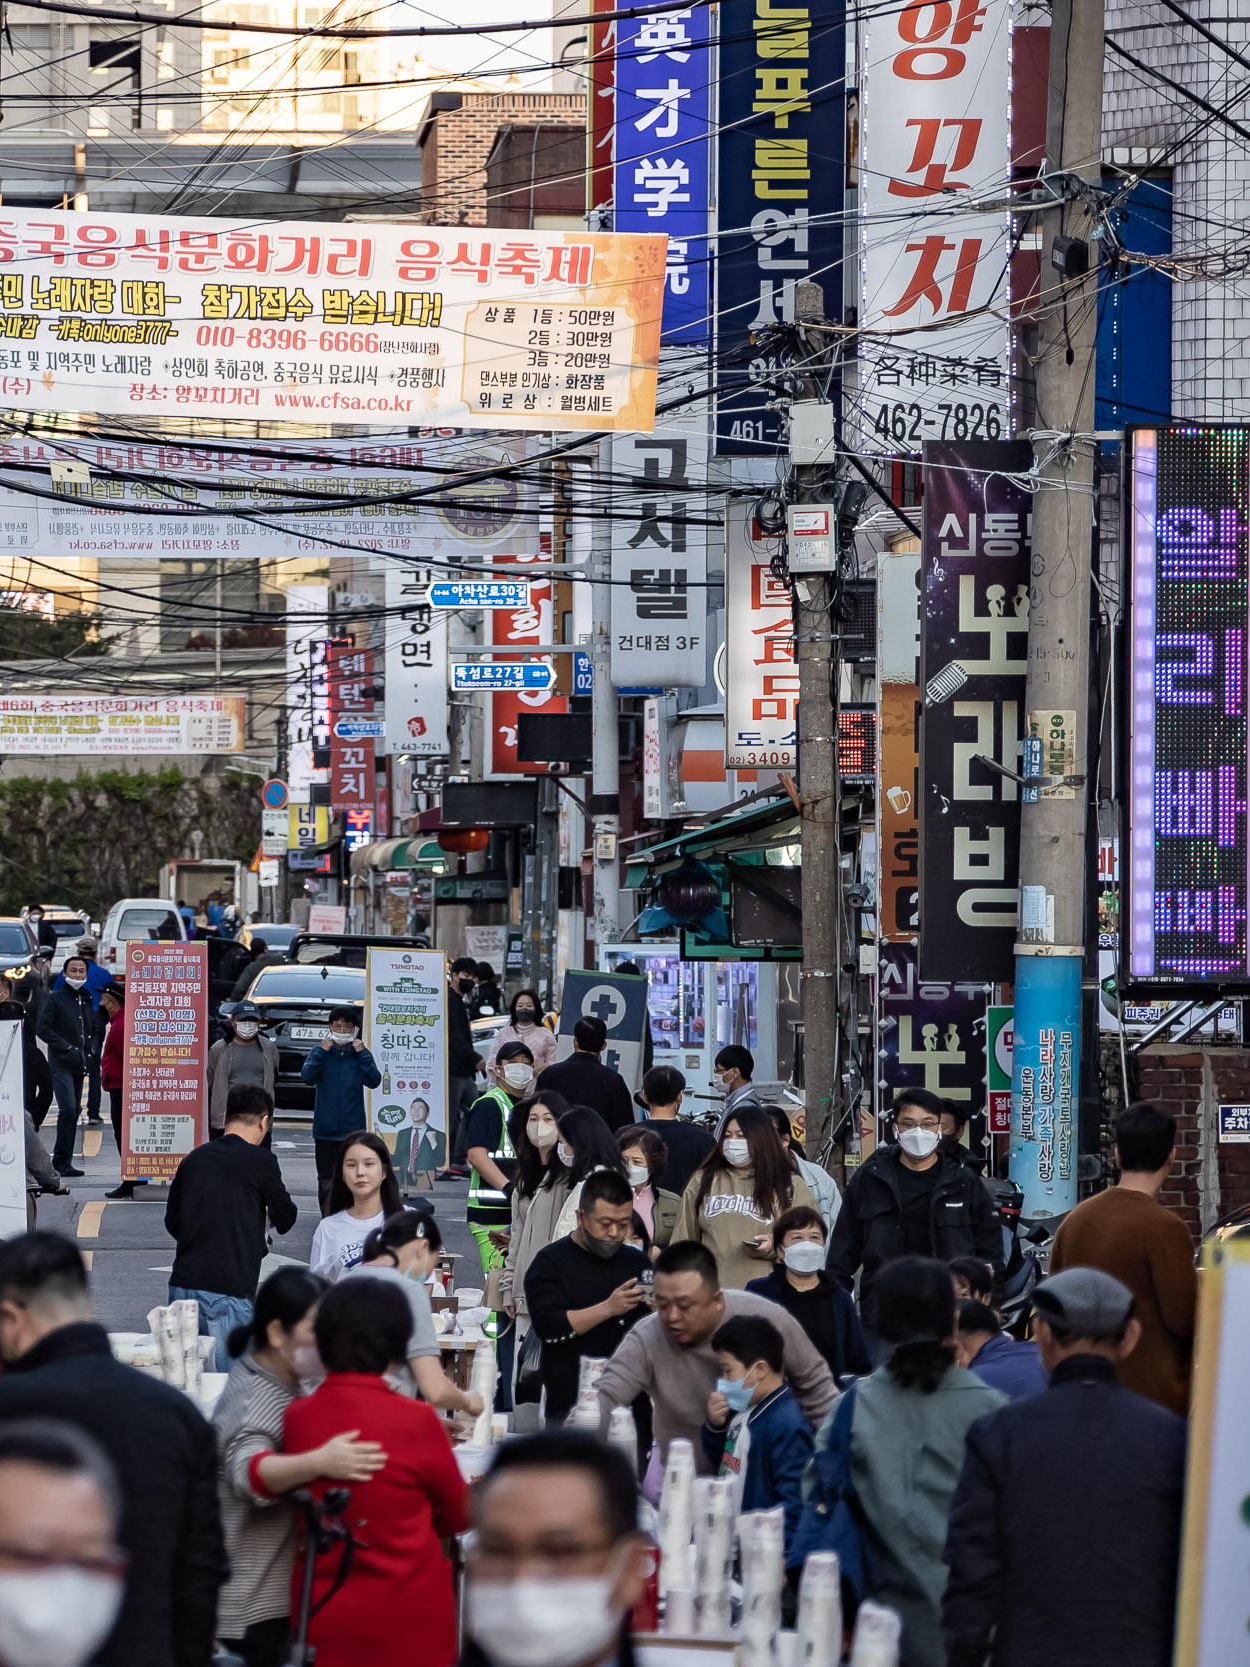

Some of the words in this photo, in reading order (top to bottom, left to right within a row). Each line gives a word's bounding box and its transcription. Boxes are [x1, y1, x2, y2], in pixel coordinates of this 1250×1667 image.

[881, 0, 987, 317] 양꼬치
[395, 239, 591, 285] 음식축제
[31, 275, 116, 315] 노래자랑
[202, 284, 313, 322] 참가접수
[322, 289, 443, 328] 받습니다!
[532, 309, 553, 325] 1등
[568, 310, 615, 326] 50만원
[196, 325, 379, 354] 010-8396-6666
[528, 330, 550, 346] 2등
[566, 332, 612, 348] 30만원
[28, 351, 39, 371] 및
[46, 351, 96, 374] 지역주민
[101, 354, 152, 377] 노래자랑
[171, 357, 208, 379] 상인회
[273, 361, 323, 384] 중국음식
[397, 366, 446, 389] 경품행사
[527, 352, 549, 367] 3등
[565, 353, 610, 369] 20만원
[874, 356, 1002, 388] 各种菜肴
[522, 373, 551, 389] 인기상
[566, 374, 605, 391] 화장품
[2, 377, 31, 395] (수)
[129, 383, 168, 402] 장소:
[175, 385, 260, 406] 양꼬치거리
[274, 391, 414, 413] www.cfsa.co.kr
[561, 395, 612, 412] 월병세트
[730, 420, 788, 444] 461-
[874, 403, 1001, 442] 462-7826
[626, 438, 689, 620] 고시텔
[937, 512, 1032, 557] 신동
[451, 585, 527, 598] 아차산로30길
[618, 635, 671, 652] 건대점
[676, 636, 700, 651] 3F
[401, 743, 442, 751] 463-7741
[390, 963, 424, 971] TSINGTAO
[130, 982, 167, 994] 중국동포및
[170, 982, 201, 994] 지역주민
[401, 986, 432, 994] TSINGTAO
[139, 996, 172, 1007] 노래자랑
[174, 996, 191, 1007] 대회
[380, 1051, 400, 1062] 함께
[403, 1052, 435, 1063] 갑니다!
[1038, 1028, 1054, 1102] 나라사랑
[1020, 1067, 1035, 1142] 운동본부
[1037, 1106, 1054, 1182] 가족사랑
